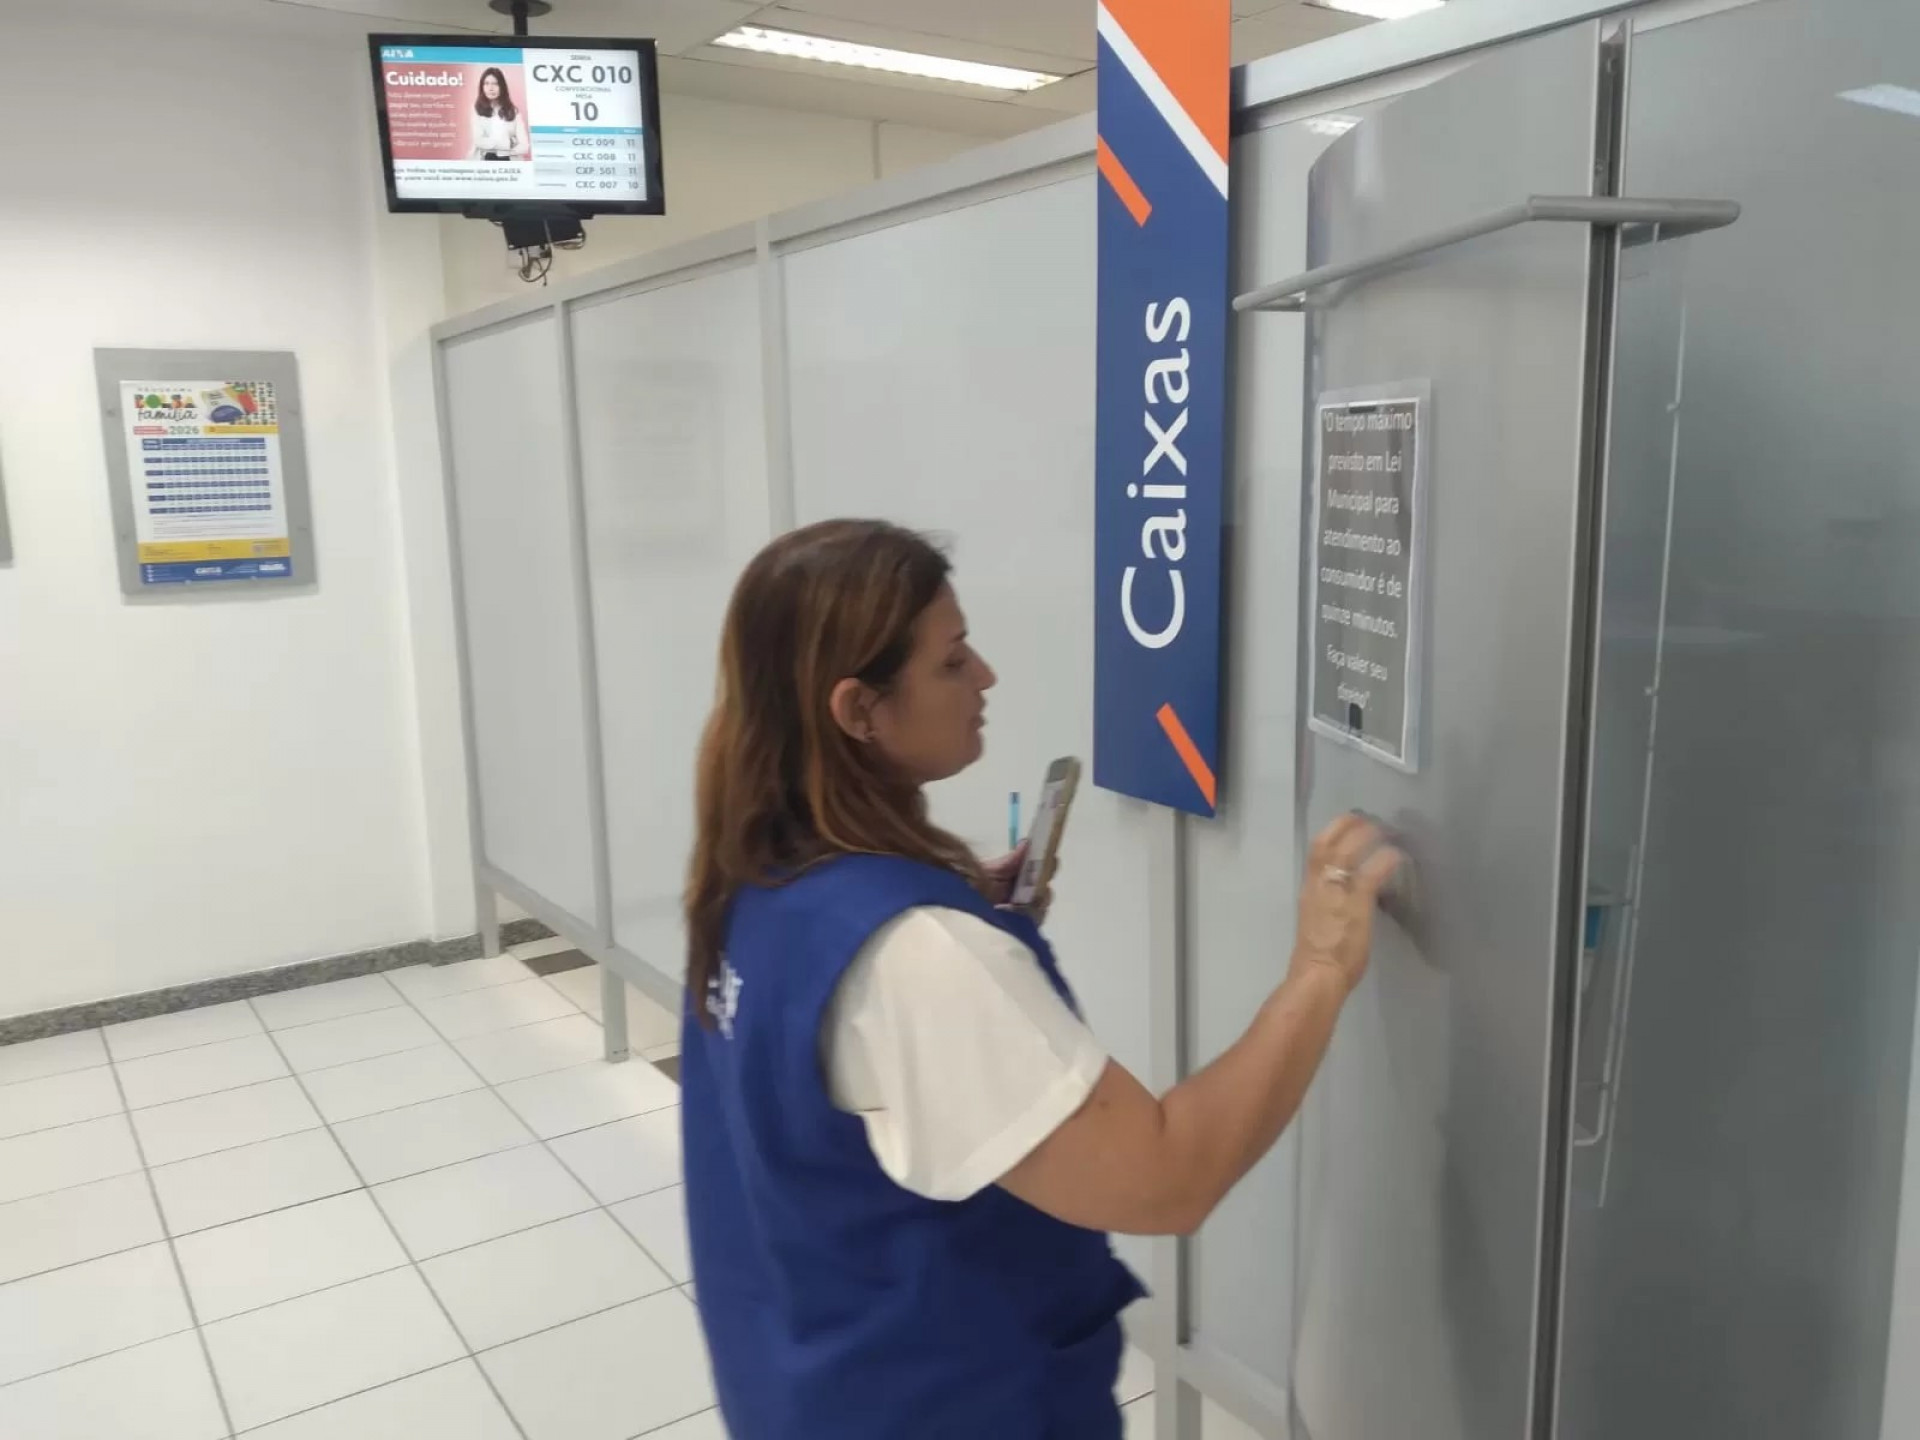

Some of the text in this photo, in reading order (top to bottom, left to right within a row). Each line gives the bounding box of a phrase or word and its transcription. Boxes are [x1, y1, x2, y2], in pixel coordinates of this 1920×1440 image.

[386, 71, 463, 86] Cuidado!
[533, 64, 632, 84] CXC 010
[570, 102, 598, 121] 10
[572, 138, 594, 147] CXC
[626, 138, 635, 147] 11
[573, 152, 594, 161] CXC
[628, 153, 636, 161] 11
[629, 167, 637, 176] 11
[575, 181, 596, 189] CXC
[628, 181, 639, 189] 10
[1327, 451, 1402, 475] previsto em Lei
[1121, 297, 1191, 649] Caixas
[1326, 489, 1399, 519] Municipal para
[1323, 527, 1401, 556] atendimento ao
[1320, 566, 1402, 598] consumidor é de
